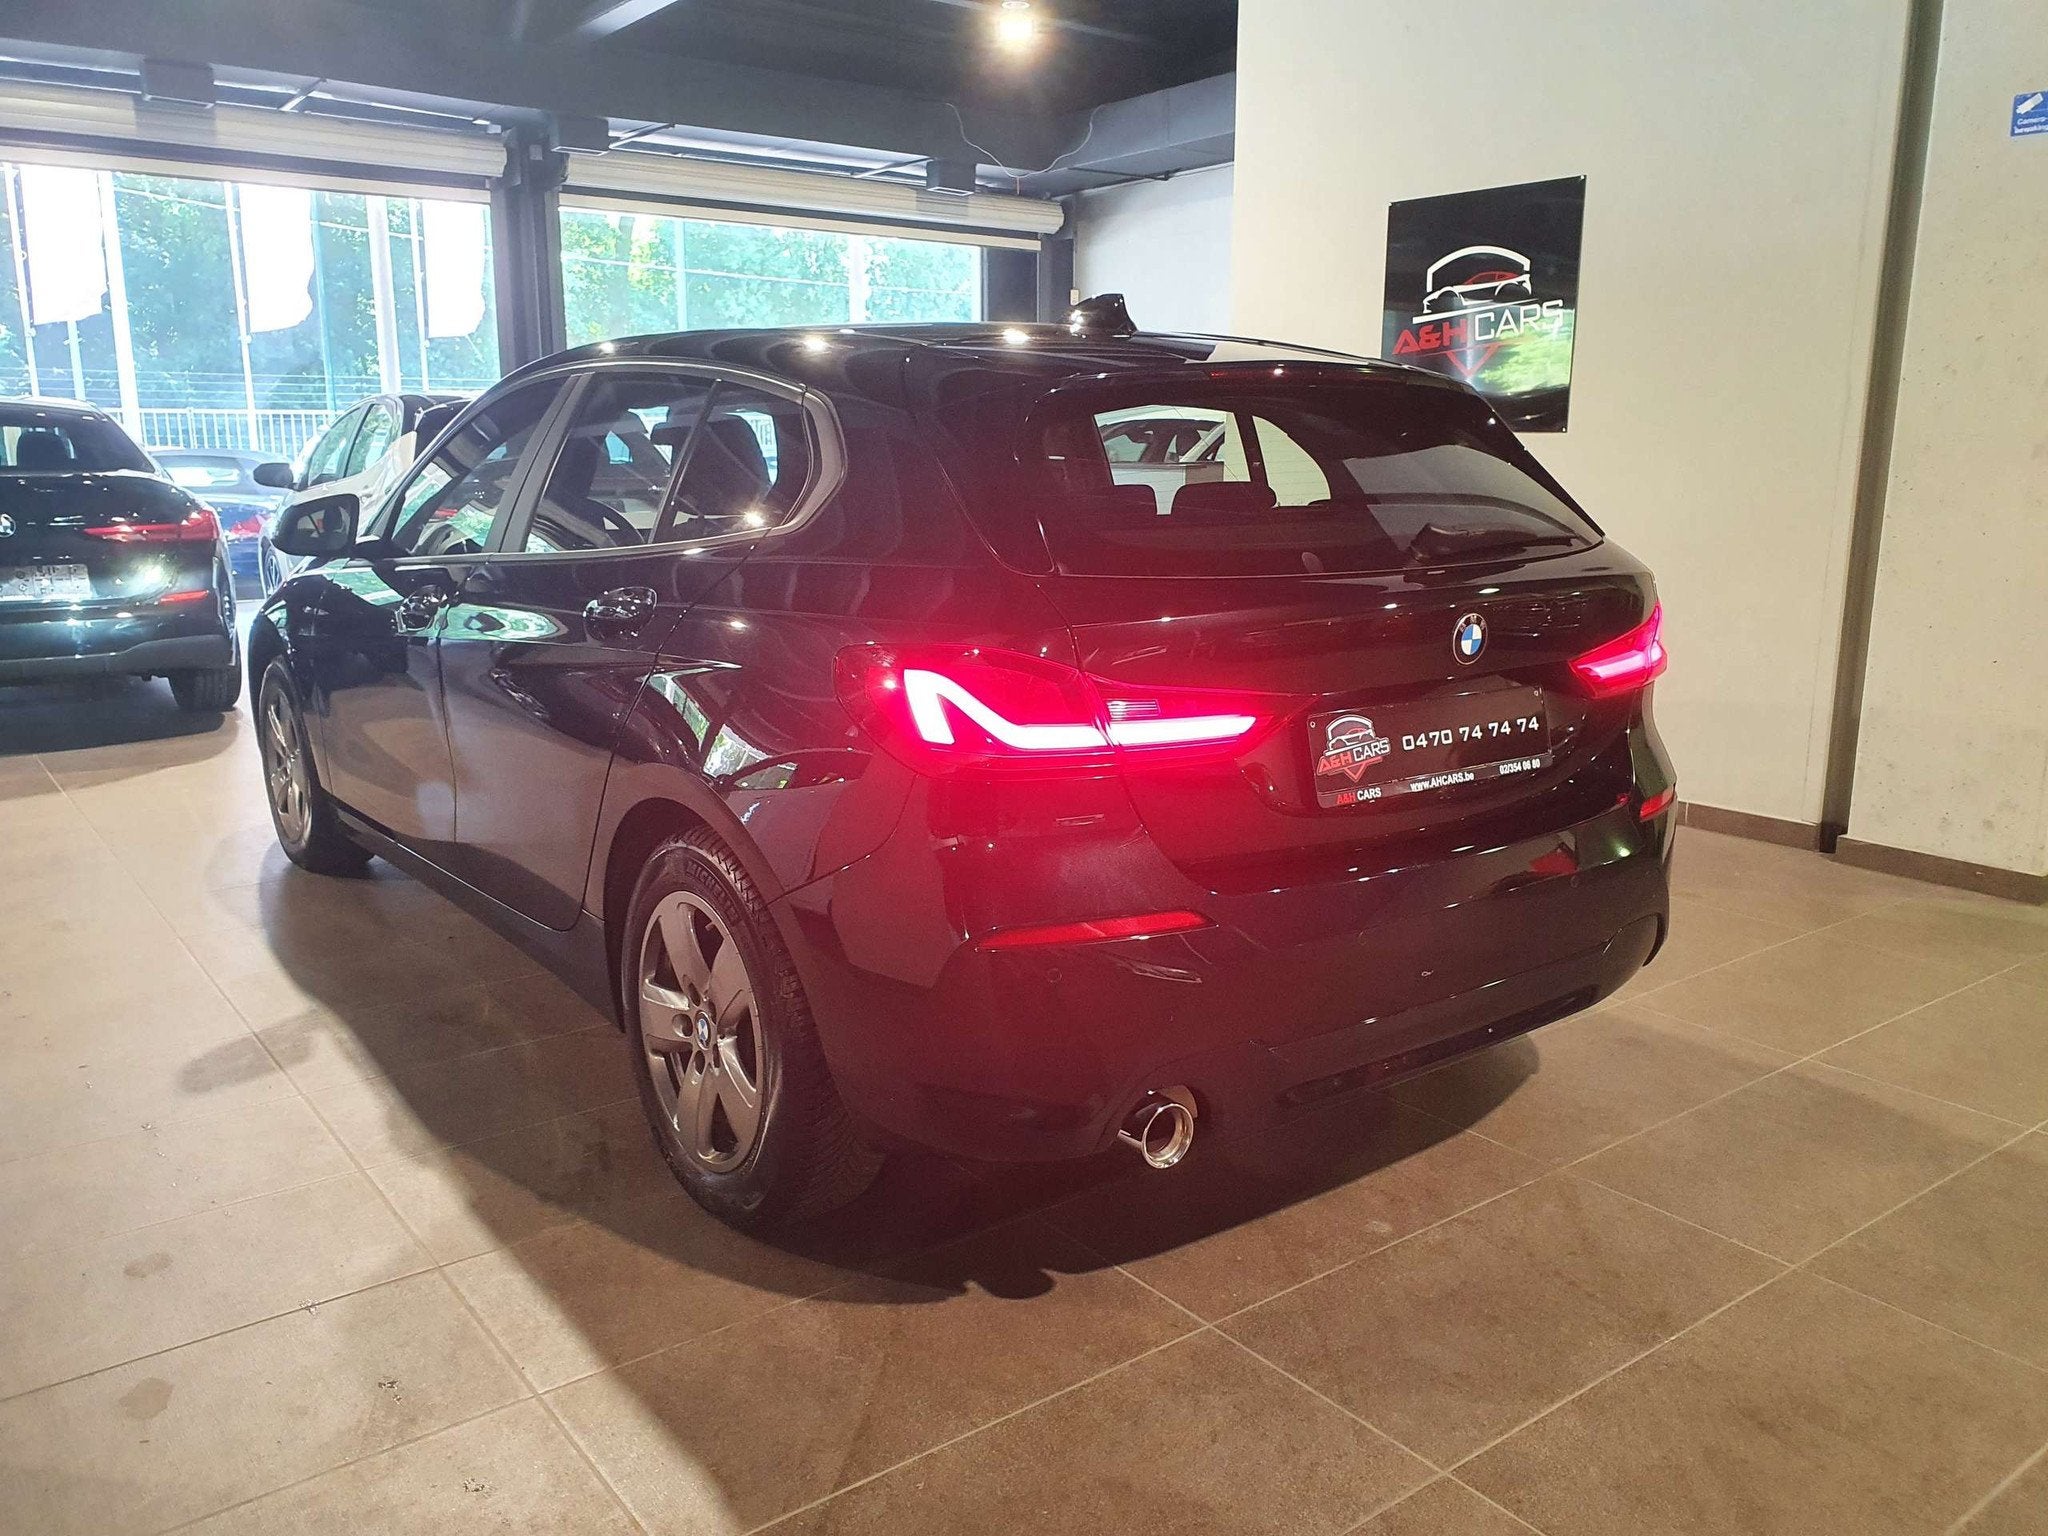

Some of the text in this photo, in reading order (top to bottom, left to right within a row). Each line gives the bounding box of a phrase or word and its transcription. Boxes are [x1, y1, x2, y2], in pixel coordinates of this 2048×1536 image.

[1392, 299, 1564, 355] A&H CARS
[1402, 716, 1540, 751] 0470 74 74 74
[1318, 739, 1390, 774] A&H CARS
[1336, 787, 1382, 805] A&H CARS
[1410, 771, 1475, 792] www.AHCARS.be
